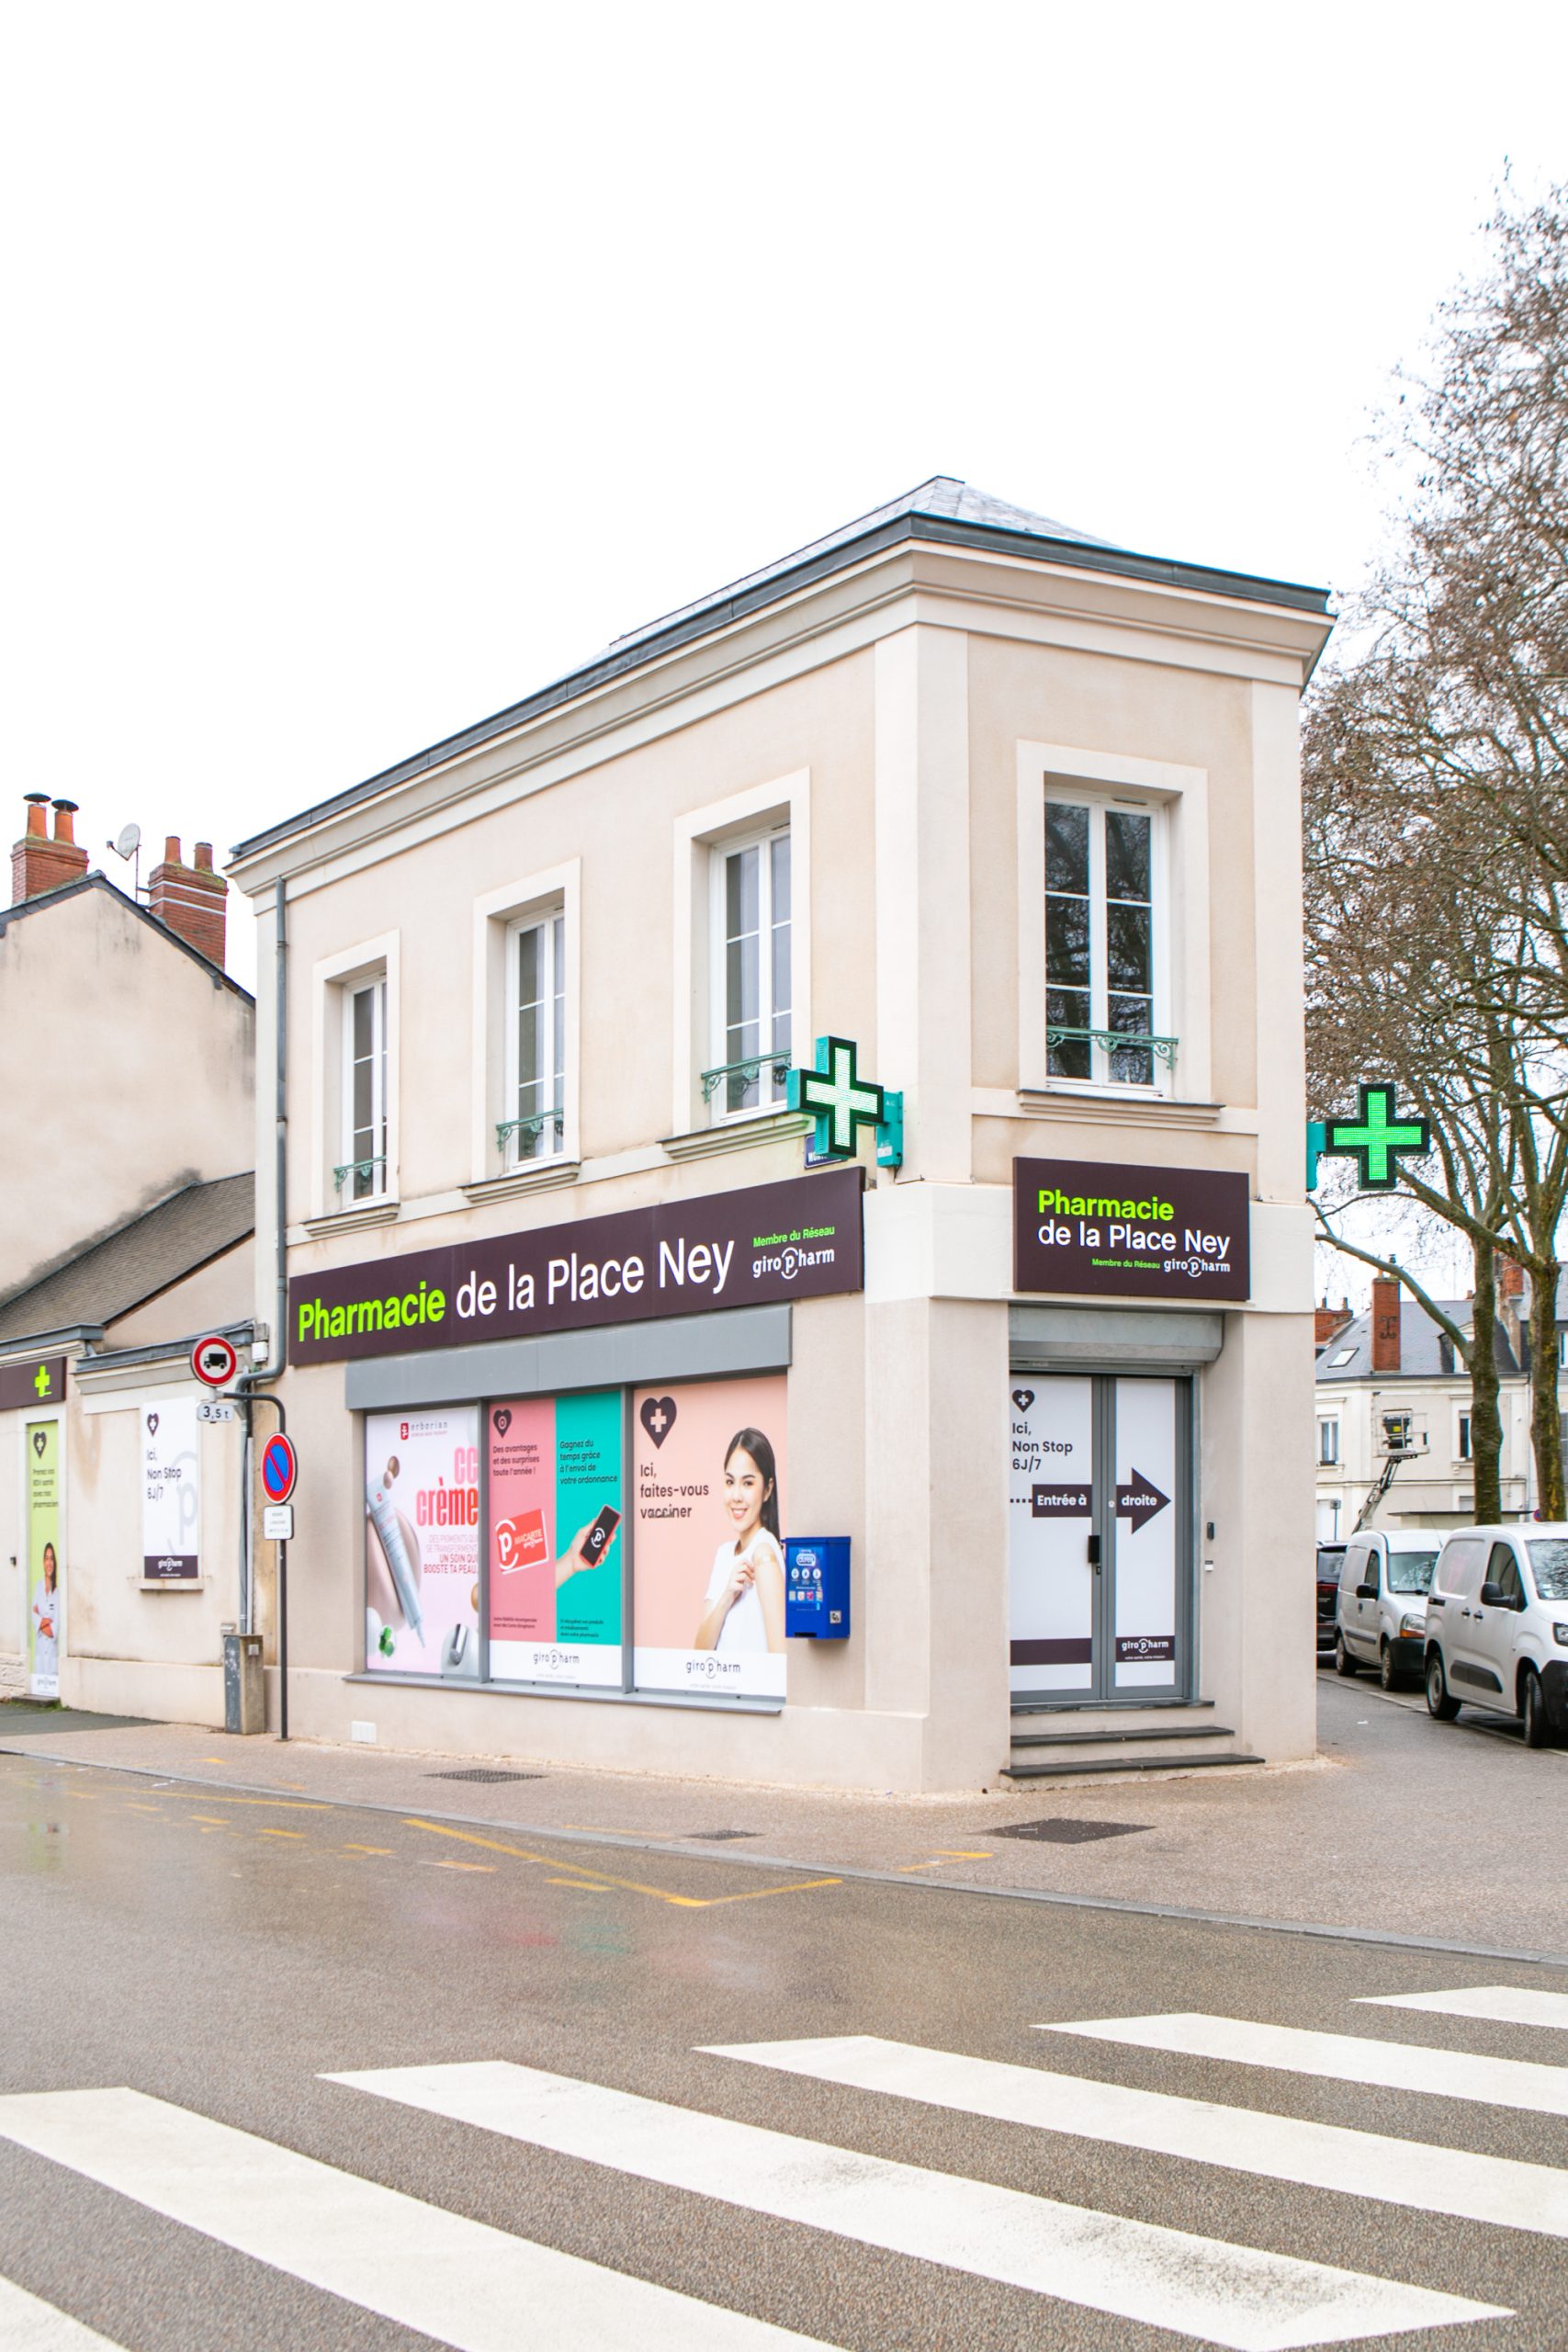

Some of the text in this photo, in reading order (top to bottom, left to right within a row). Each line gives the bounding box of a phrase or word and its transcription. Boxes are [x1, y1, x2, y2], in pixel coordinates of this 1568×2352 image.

[1038, 1189, 1175, 1221] Pharmacie
[752, 1226, 835, 1248] Membre du Réseau
[1038, 1219, 1231, 1260] de la Place Ney
[752, 1247, 835, 1278] giropharm
[1092, 1259, 1161, 1269] Membre du Réseau
[1164, 1258, 1231, 1273] giropharm
[299, 1238, 735, 1342] Pharmacie de la Place Ney
[203, 1406, 230, 1419] 3,5 t
[1012, 1422, 1032, 1436] Ici,
[505, 1443, 537, 1454] avantages
[559, 1439, 594, 1451] Gagnez du
[1012, 1441, 1074, 1455] Non Stop
[147, 1448, 157, 1462] Ici,
[512, 1455, 540, 1465] surprises
[559, 1452, 601, 1463] temps grâce
[559, 1464, 565, 1473] à
[588, 1463, 596, 1471] de
[640, 1462, 657, 1478] Ici,
[1012, 1455, 1042, 1473] 6J/7
[147, 1467, 182, 1483] Non Stop
[493, 1468, 509, 1476] toute
[510, 1468, 532, 1476] l'année
[559, 1475, 618, 1485] votre ordonnance
[640, 1484, 709, 1498] faites-vous
[416, 1476, 479, 1526] crème
[1037, 1493, 1157, 1507] Entrée à droite
[640, 1504, 693, 1519] vacciner
[440, 1554, 448, 1563] UN
[450, 1554, 465, 1563] SOIN
[423, 1564, 448, 1574] BOOSTE
[449, 1564, 457, 1574] TA
[1122, 1639, 1169, 1652] giropharm
[534, 1651, 580, 1665] giropharm
[686, 1658, 741, 1674] giropharm
